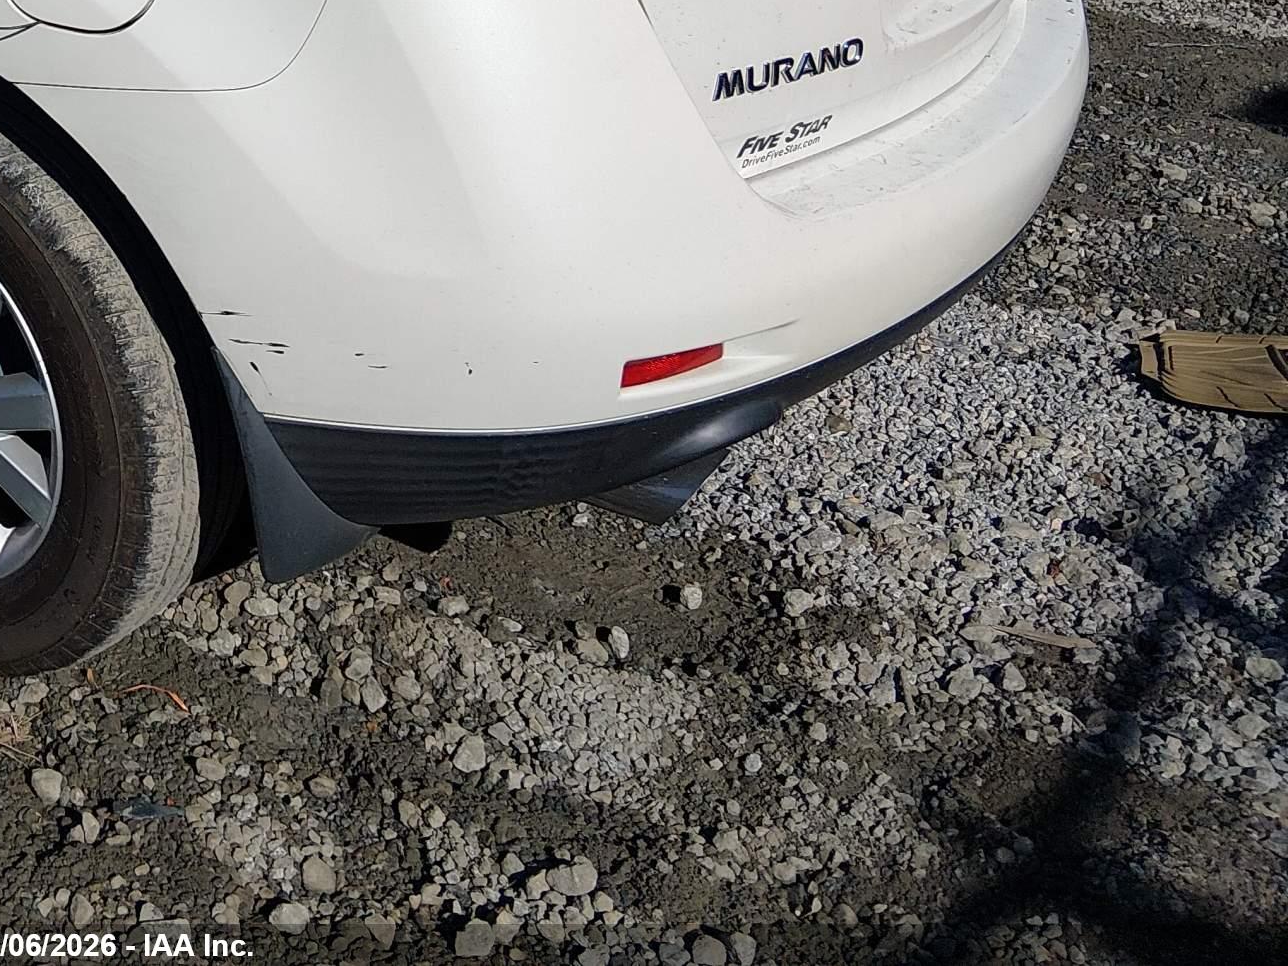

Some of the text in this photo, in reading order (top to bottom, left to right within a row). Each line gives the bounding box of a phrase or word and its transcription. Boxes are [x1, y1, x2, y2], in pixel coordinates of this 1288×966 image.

[712, 37, 864, 101] MURANO
[736, 114, 833, 159] FIVE STAR
[741, 136, 821, 169] DriveFiveStar.com
